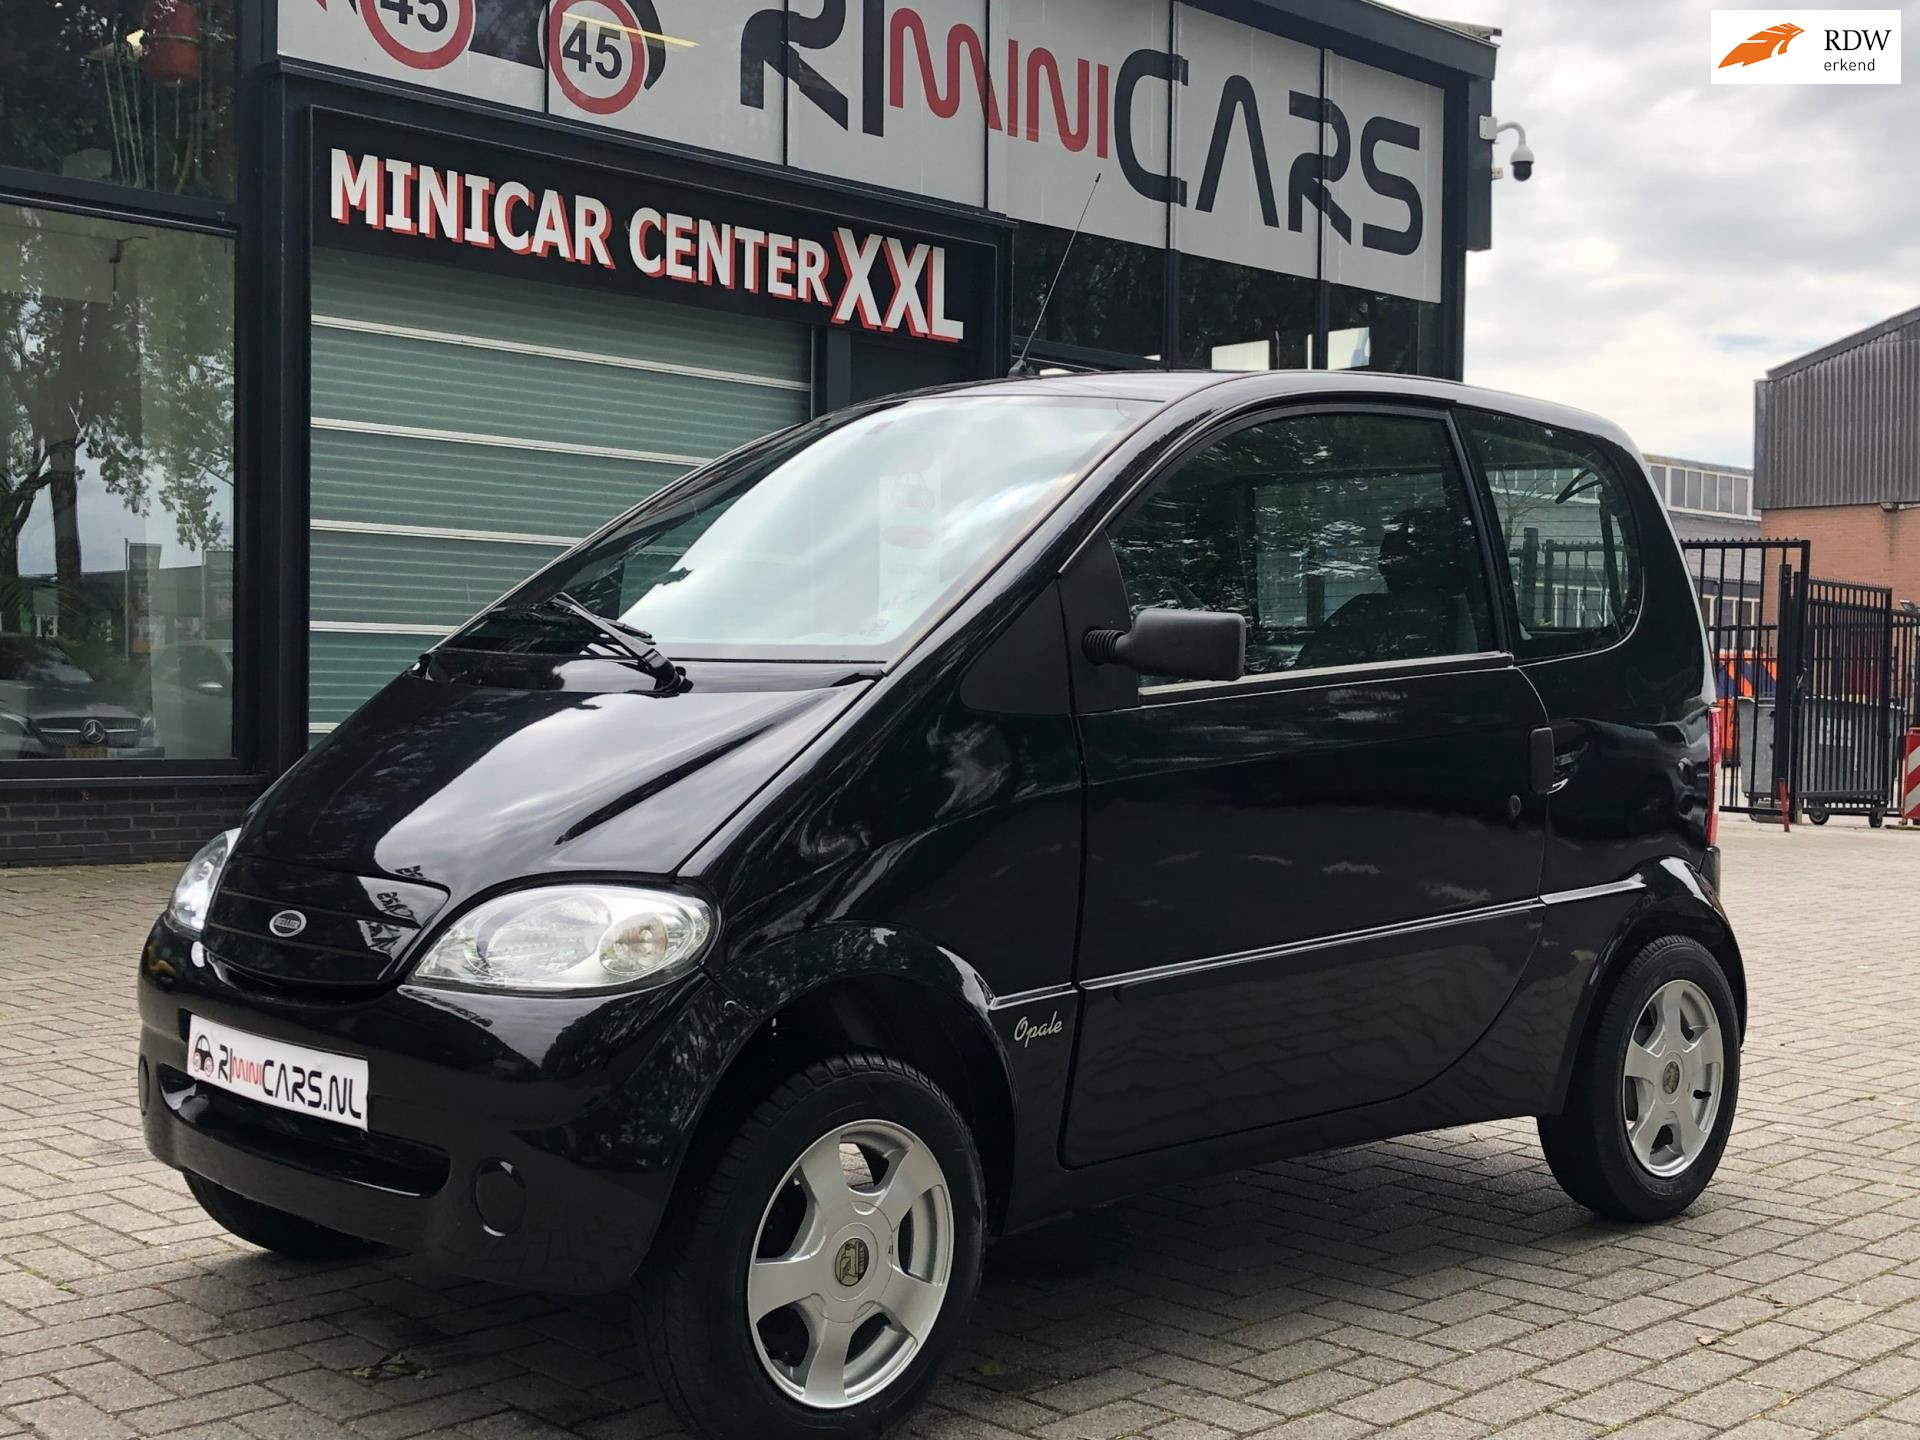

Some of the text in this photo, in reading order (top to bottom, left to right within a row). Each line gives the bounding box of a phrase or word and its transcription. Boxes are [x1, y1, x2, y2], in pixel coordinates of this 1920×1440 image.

[562, 20, 622, 80] 45
[330, 148, 964, 343] MINICAR CENTER XXL
[1014, 1009, 1063, 1049] Opale
